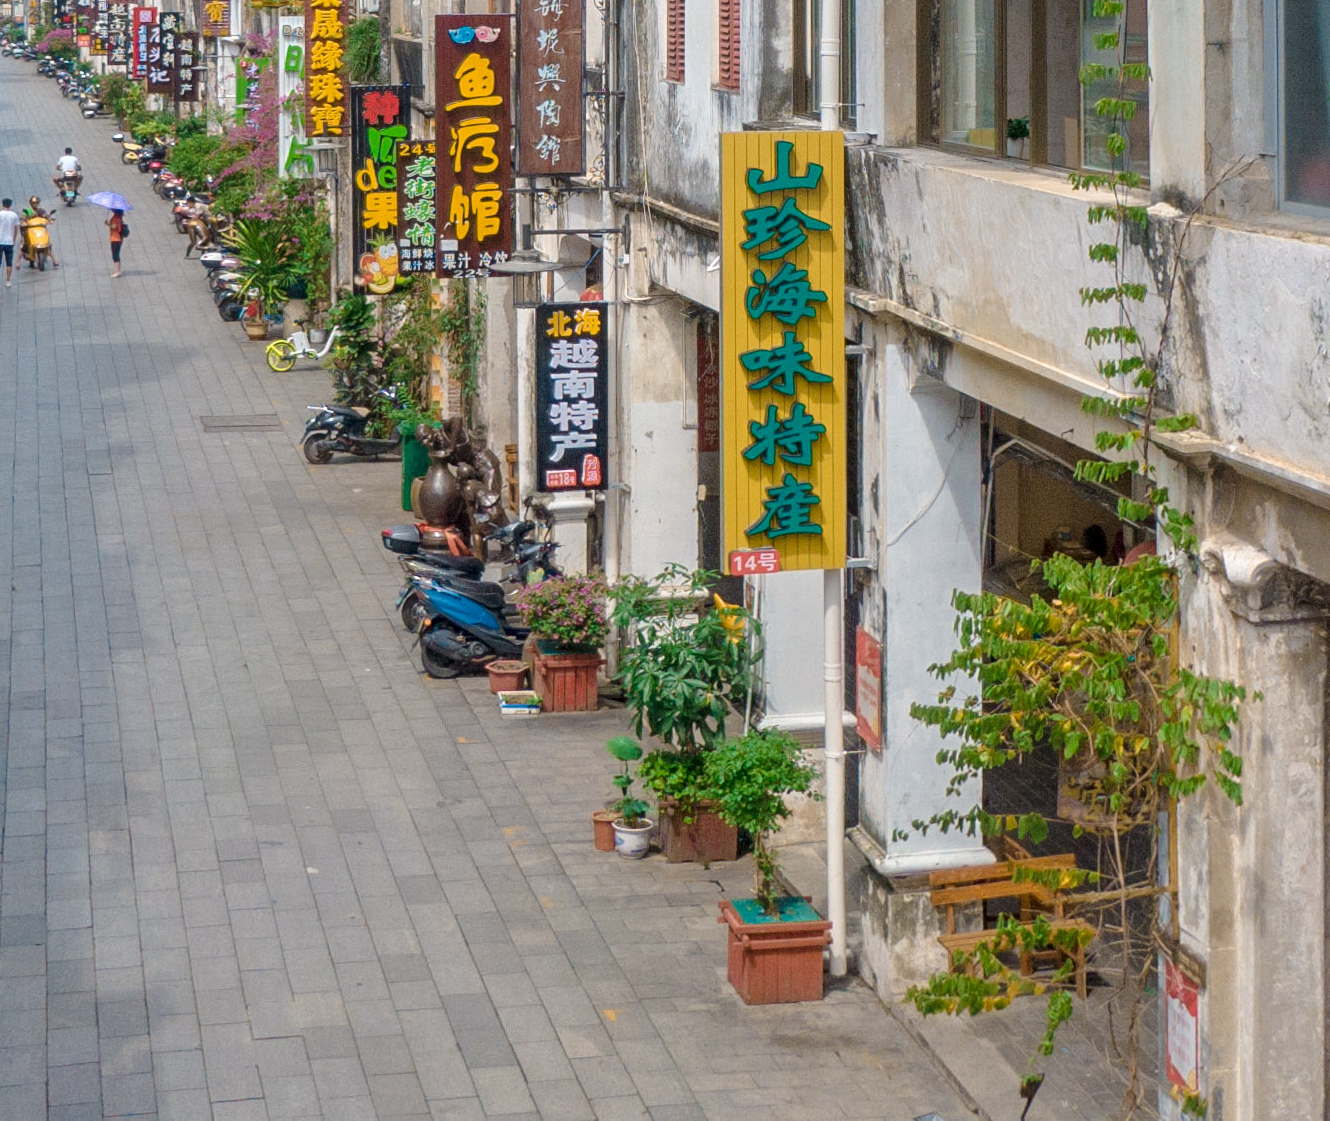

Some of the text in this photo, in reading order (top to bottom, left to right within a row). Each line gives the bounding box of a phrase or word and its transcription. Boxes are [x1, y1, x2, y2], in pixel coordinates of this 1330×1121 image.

[445, 52, 503, 242] 鱼疗馆
[443, 252, 472, 270] 果汁
[546, 307, 601, 338] 北海
[739, 140, 834, 540] 山珍海味特產
[549, 339, 598, 462] 越南特产
[733, 553, 777, 572] 14号
